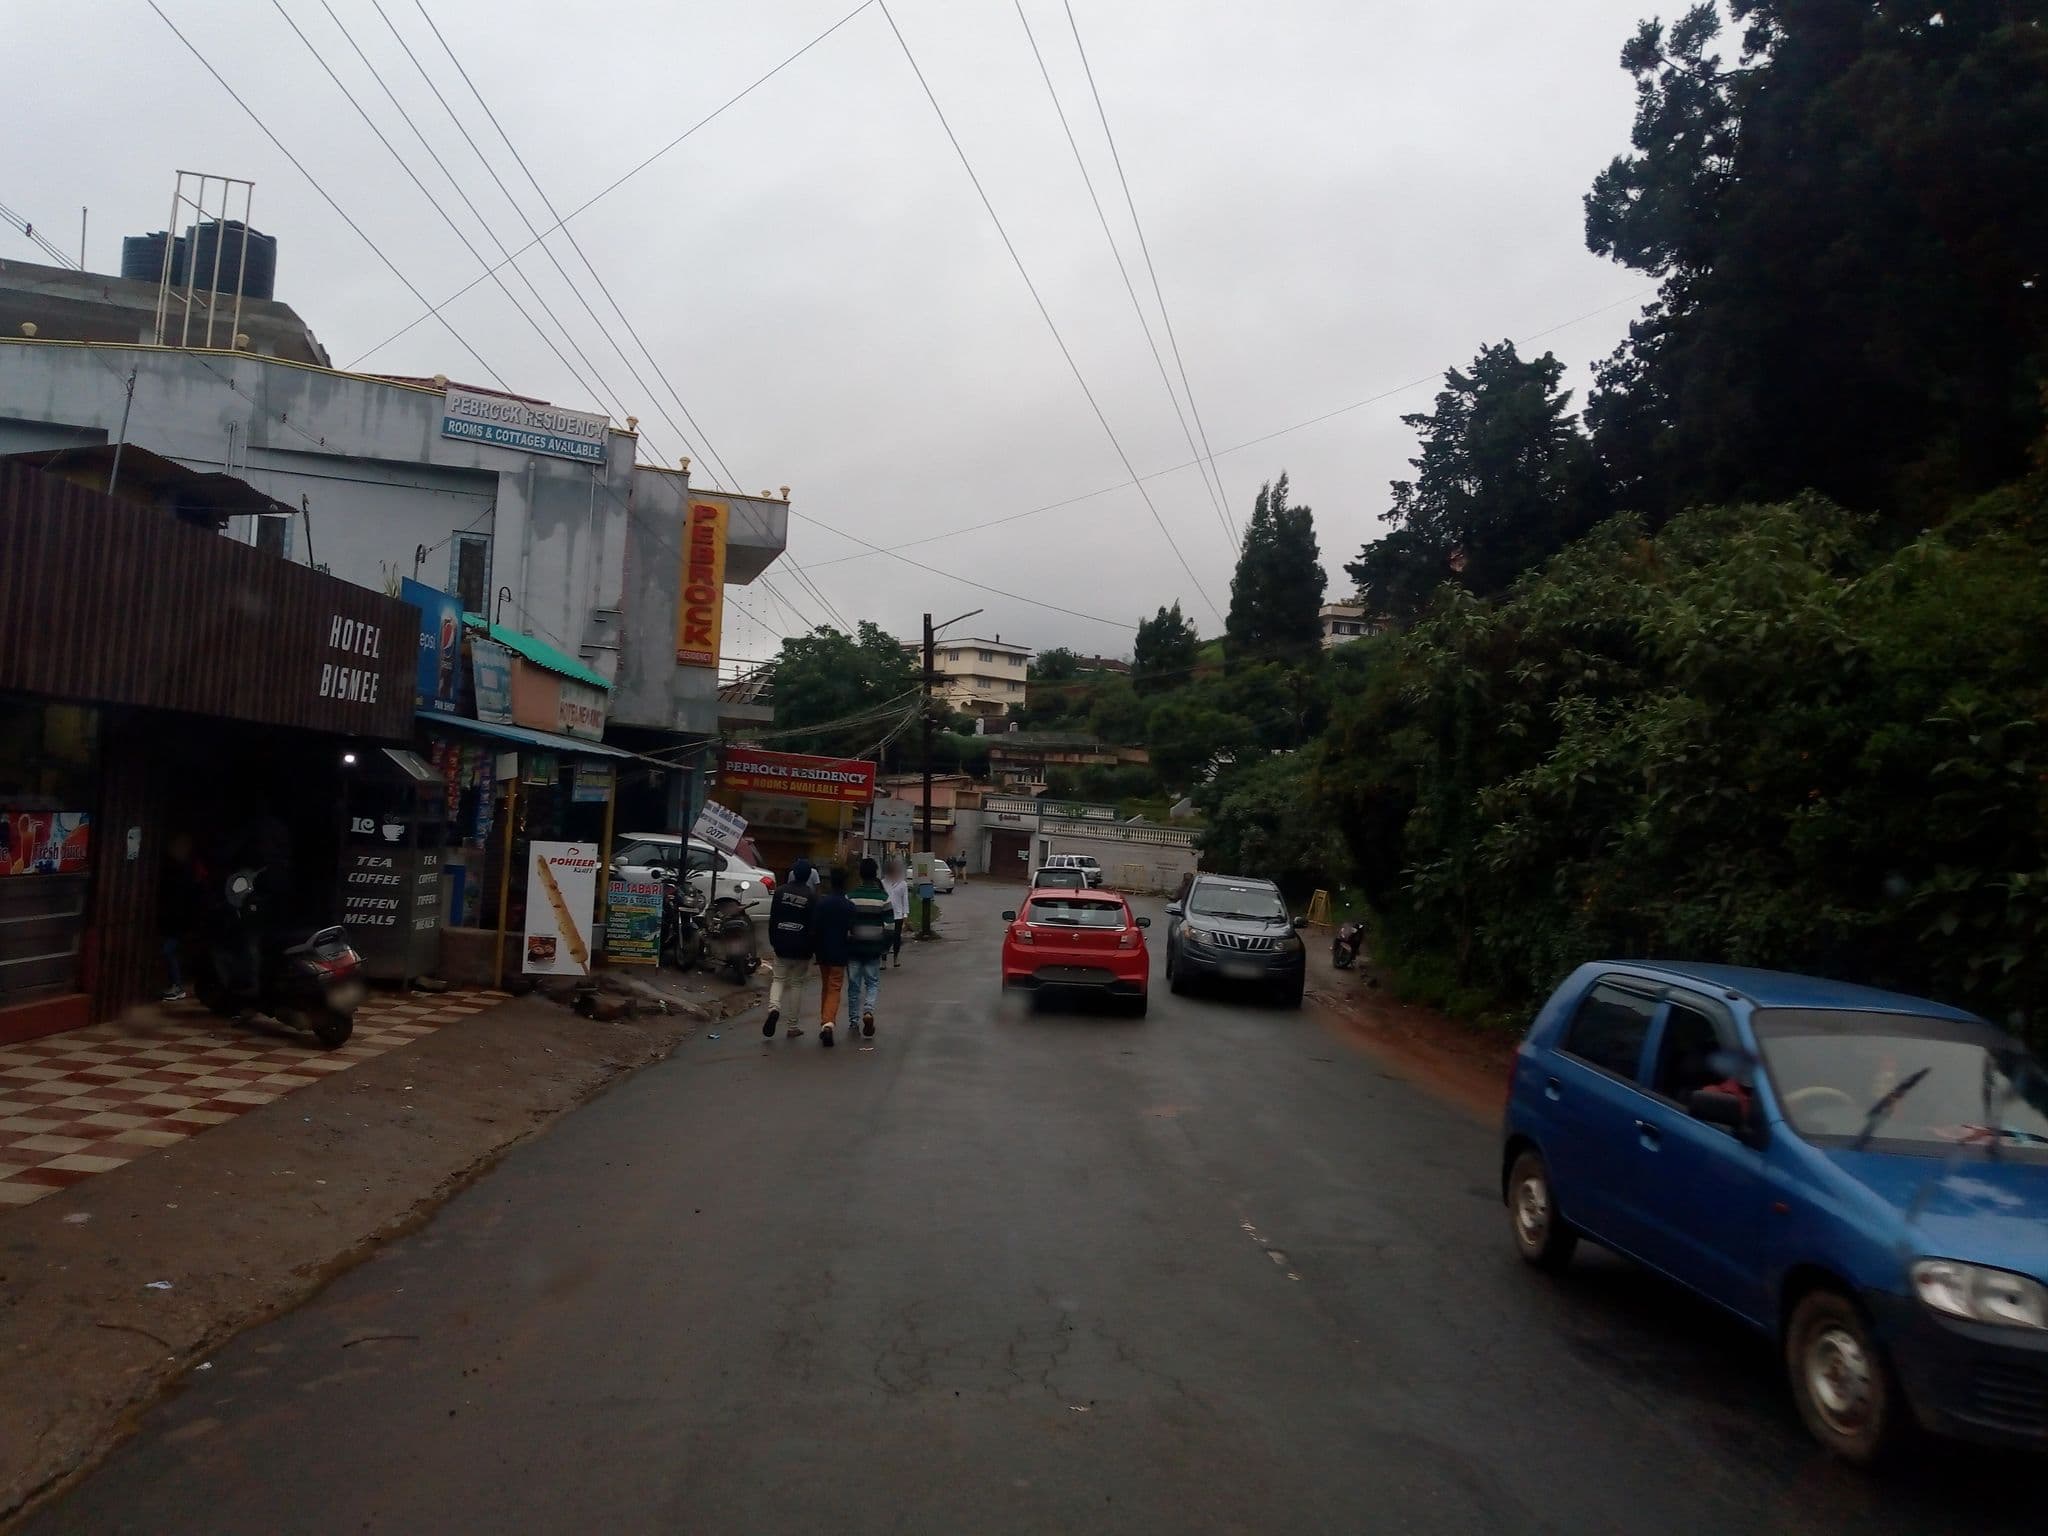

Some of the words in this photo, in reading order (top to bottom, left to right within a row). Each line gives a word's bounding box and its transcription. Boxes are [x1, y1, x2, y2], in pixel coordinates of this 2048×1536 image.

[450, 394, 521, 425] PEBROCK
[523, 409, 608, 440] RESIDENCY
[448, 420, 483, 438] ROOMS
[485, 427, 493, 439] &
[495, 428, 547, 450] COTTAGES
[548, 438, 600, 458] AVAILABLE
[684, 504, 719, 648] PEBROCK
[329, 614, 381, 660] HOTEL
[418, 632, 437, 650] epsi
[319, 663, 380, 704] BISMEE
[791, 767, 868, 784] RESIDENCY
[752, 776, 788, 790] ROOMS
[789, 780, 840, 795] AVAILABLE
[357, 856, 393, 868] TEA
[423, 855, 438, 866] TEA
[347, 872, 400, 886] COFFEE
[609, 881, 624, 893] SRI
[626, 884, 662, 895] SABARI
[345, 896, 400, 910] TIFFEN
[343, 913, 397, 926] MEALS
